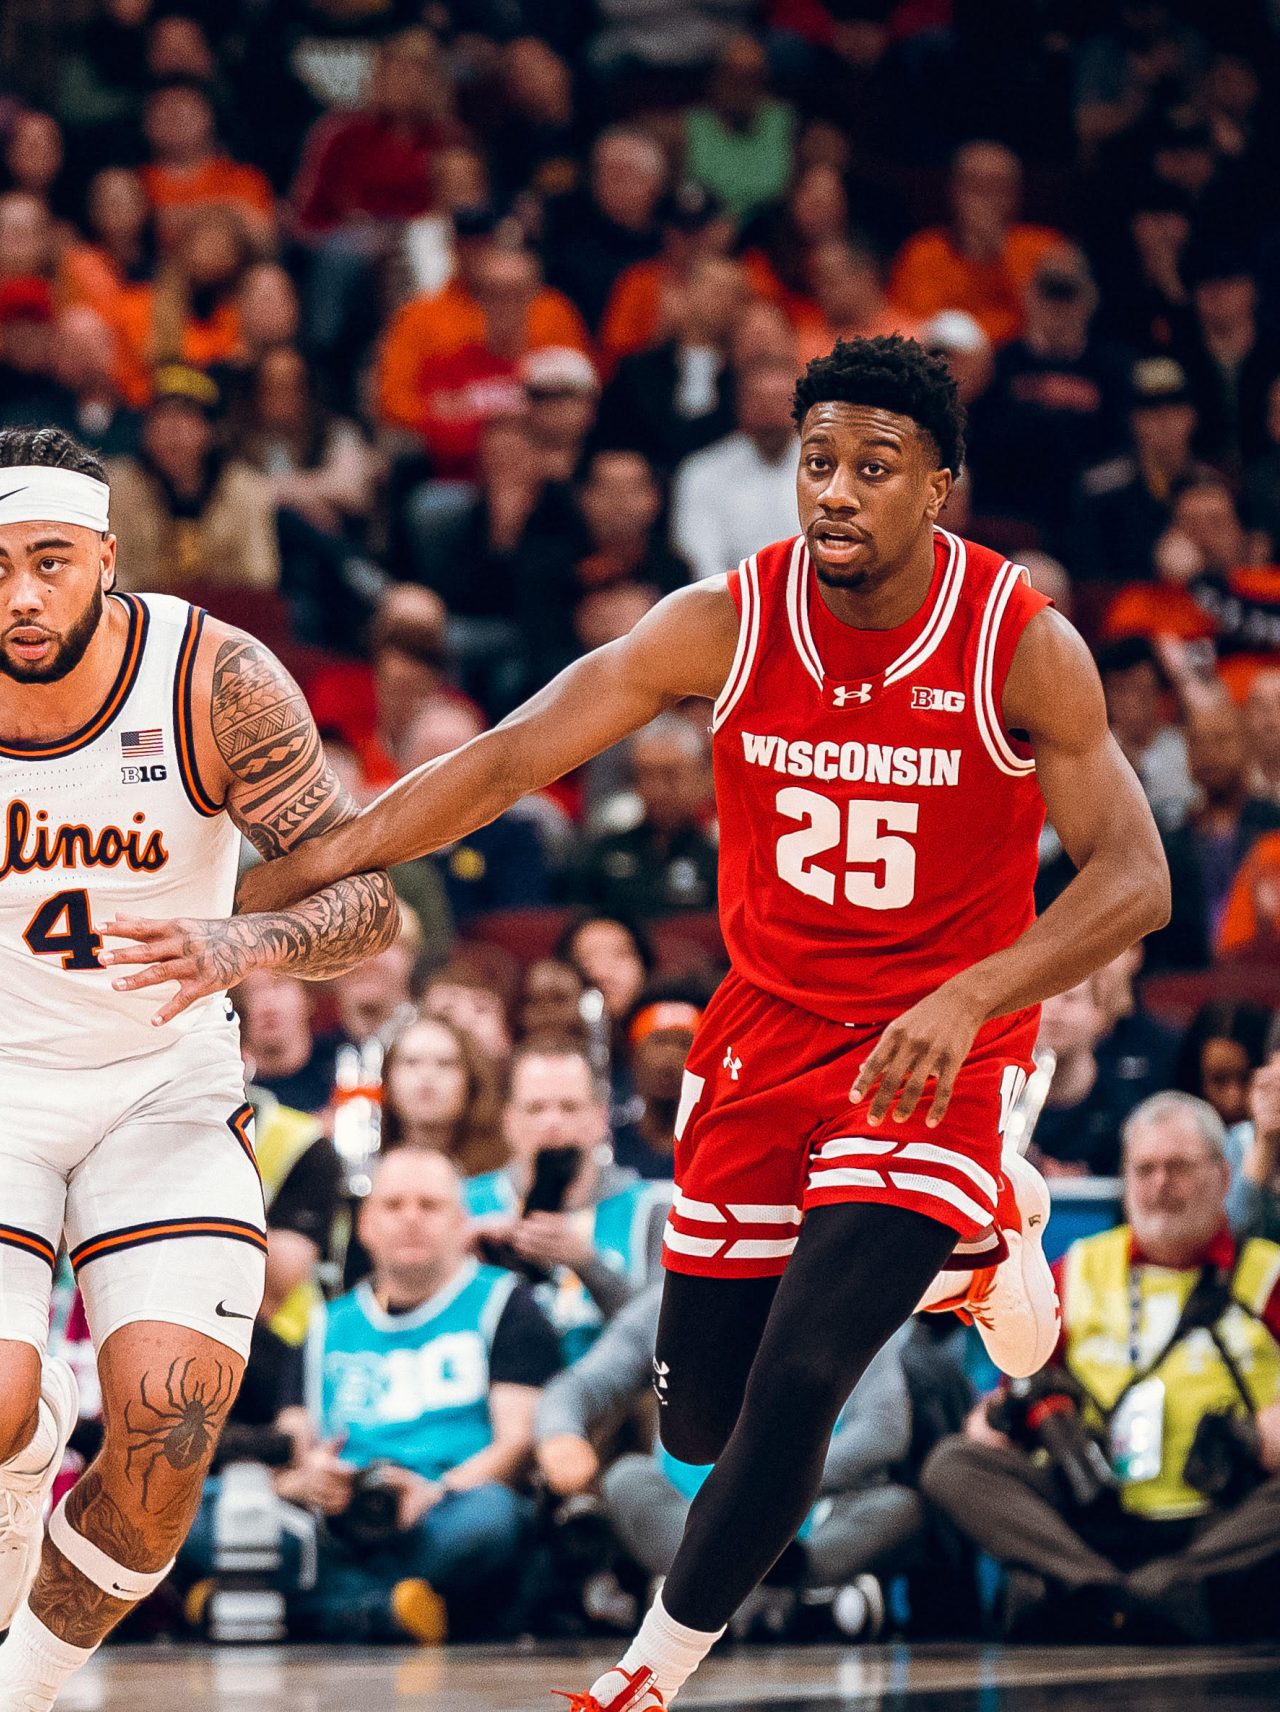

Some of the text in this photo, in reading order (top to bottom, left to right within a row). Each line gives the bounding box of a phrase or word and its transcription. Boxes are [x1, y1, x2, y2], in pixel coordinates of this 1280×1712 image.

[741, 731, 962, 786] WISCONSIN
[775, 786, 919, 910] 25
[21, 887, 107, 970] 4
